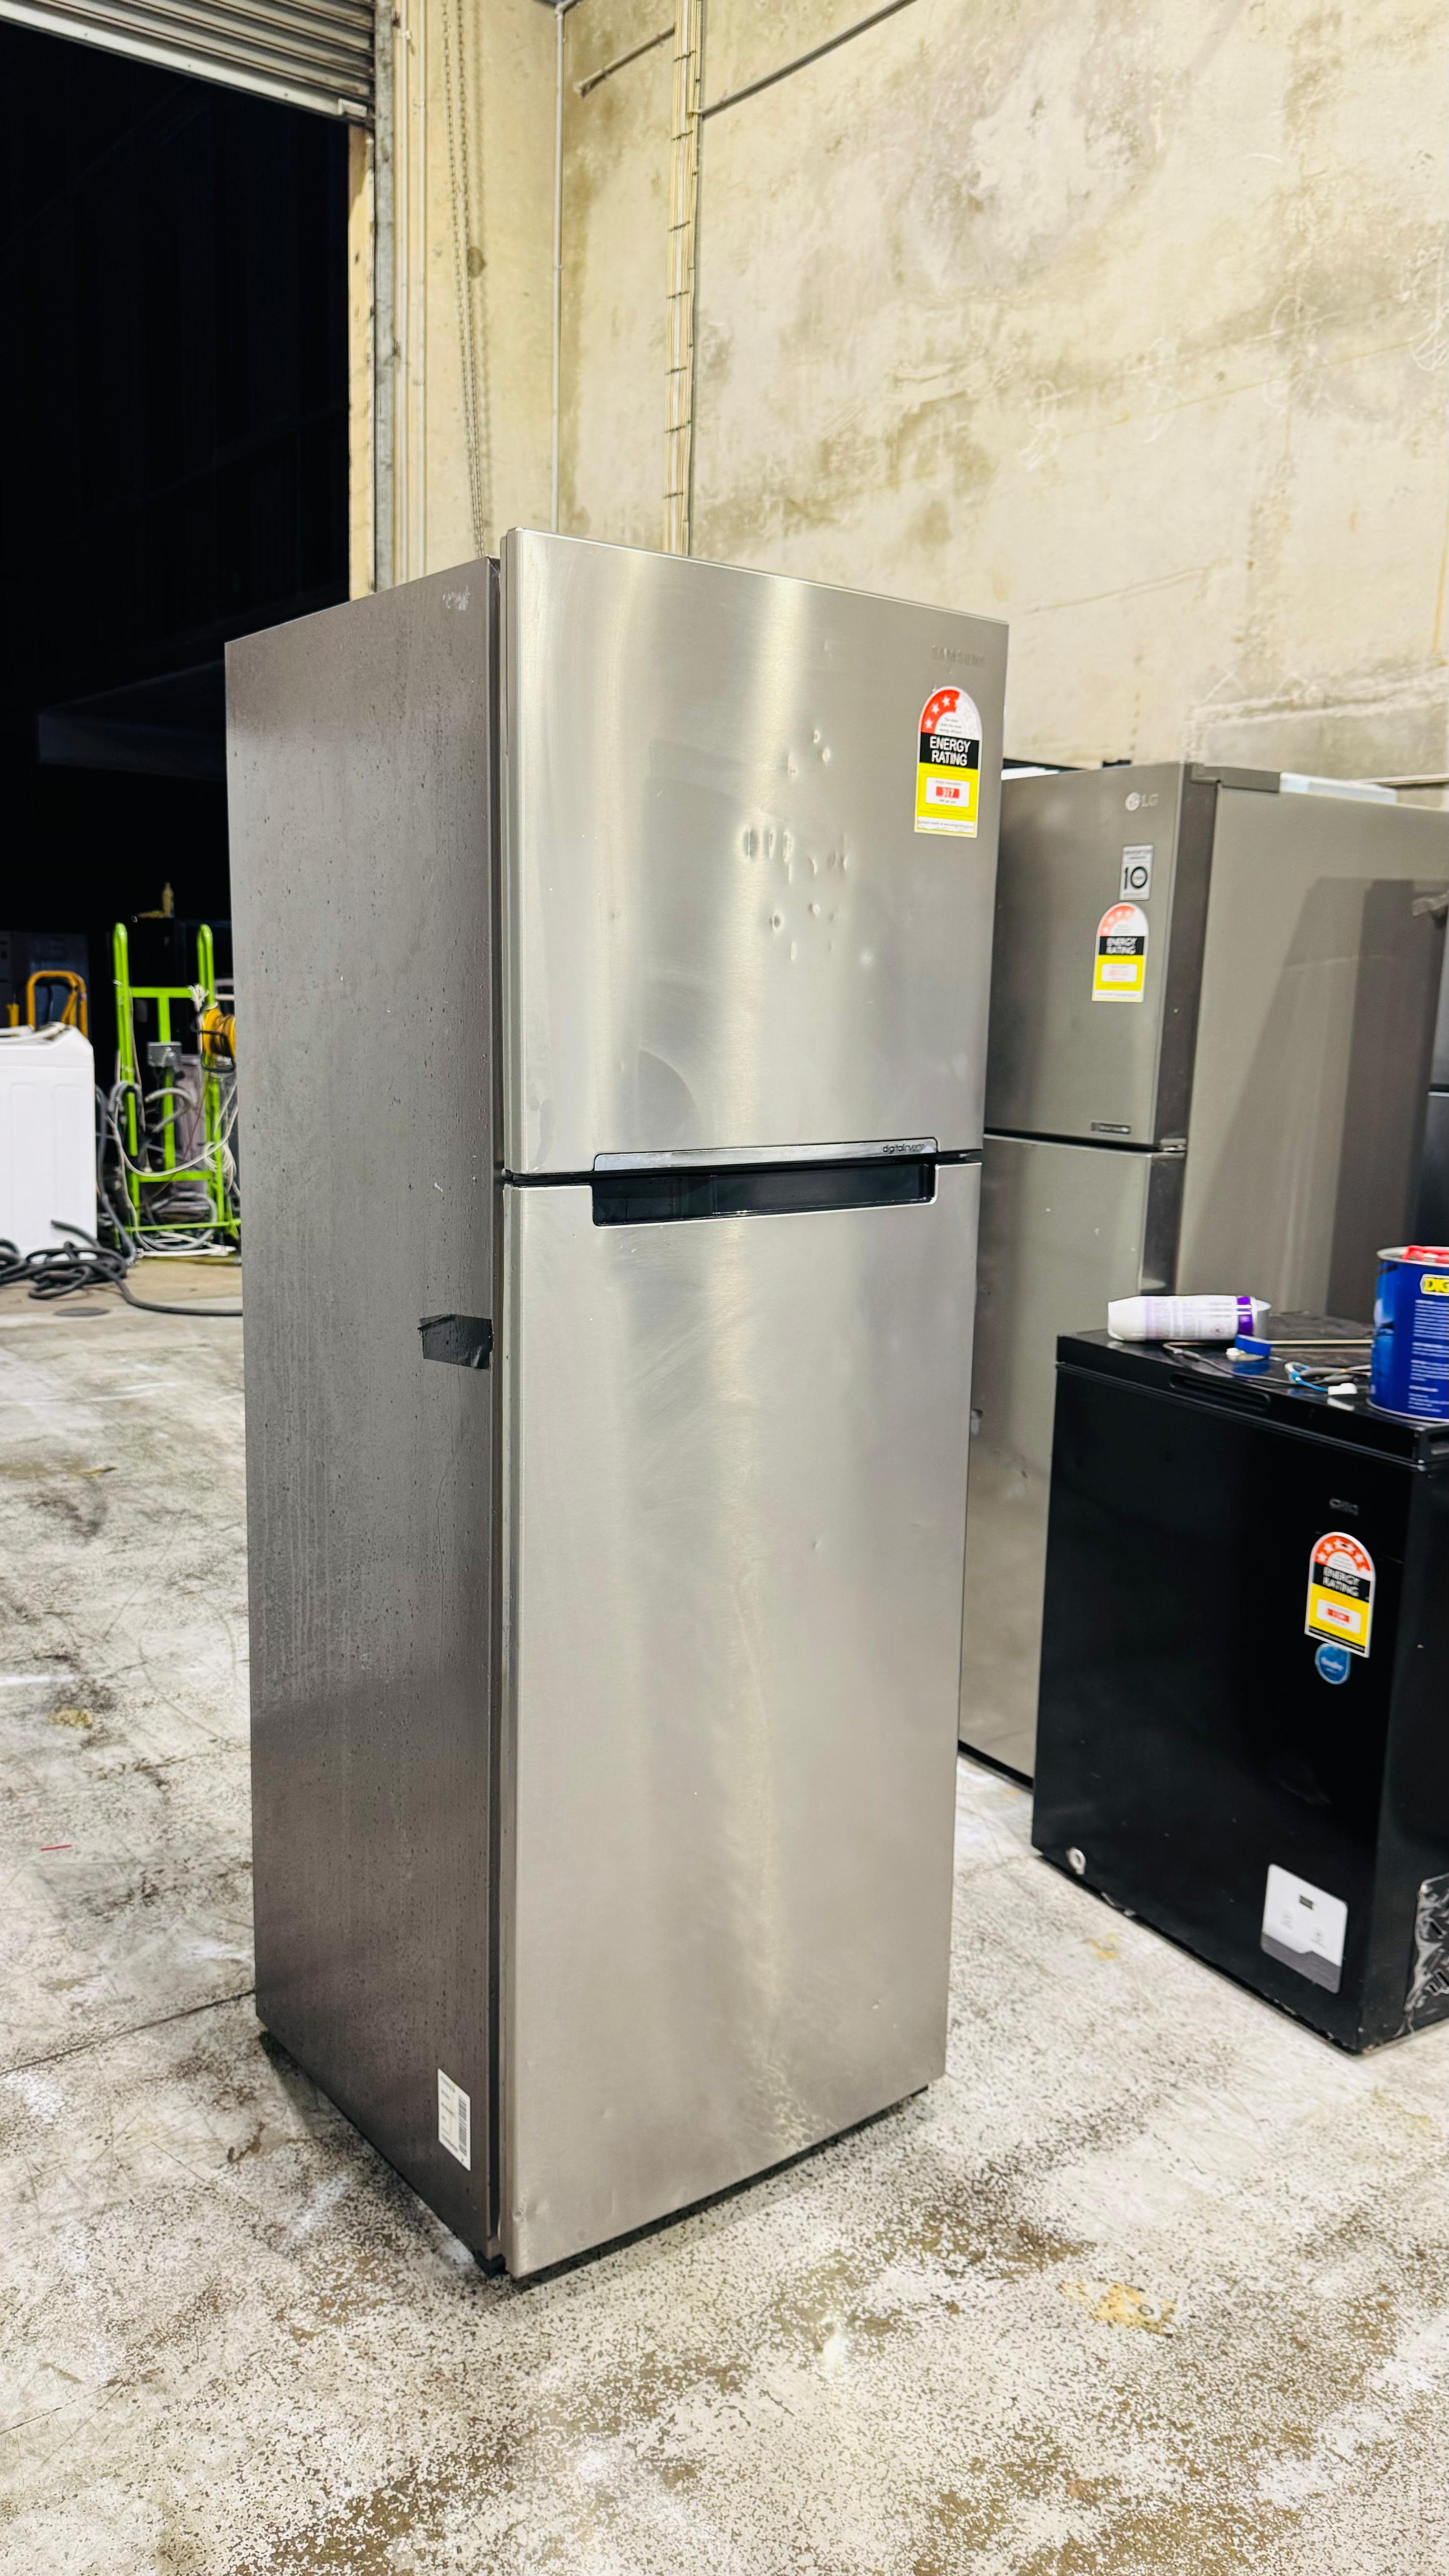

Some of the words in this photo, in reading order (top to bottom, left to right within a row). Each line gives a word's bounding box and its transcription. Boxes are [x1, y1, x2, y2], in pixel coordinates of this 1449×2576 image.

[930, 736, 971, 753] ENERGY
[931, 750, 967, 766] RATING
[1124, 866, 1148, 890] 10
[1106, 937, 1137, 946] ENERGY
[1106, 945, 1136, 954] RATING
[1323, 1566, 1359, 1586] ENERGY
[1323, 1576, 1359, 1596] RATING
